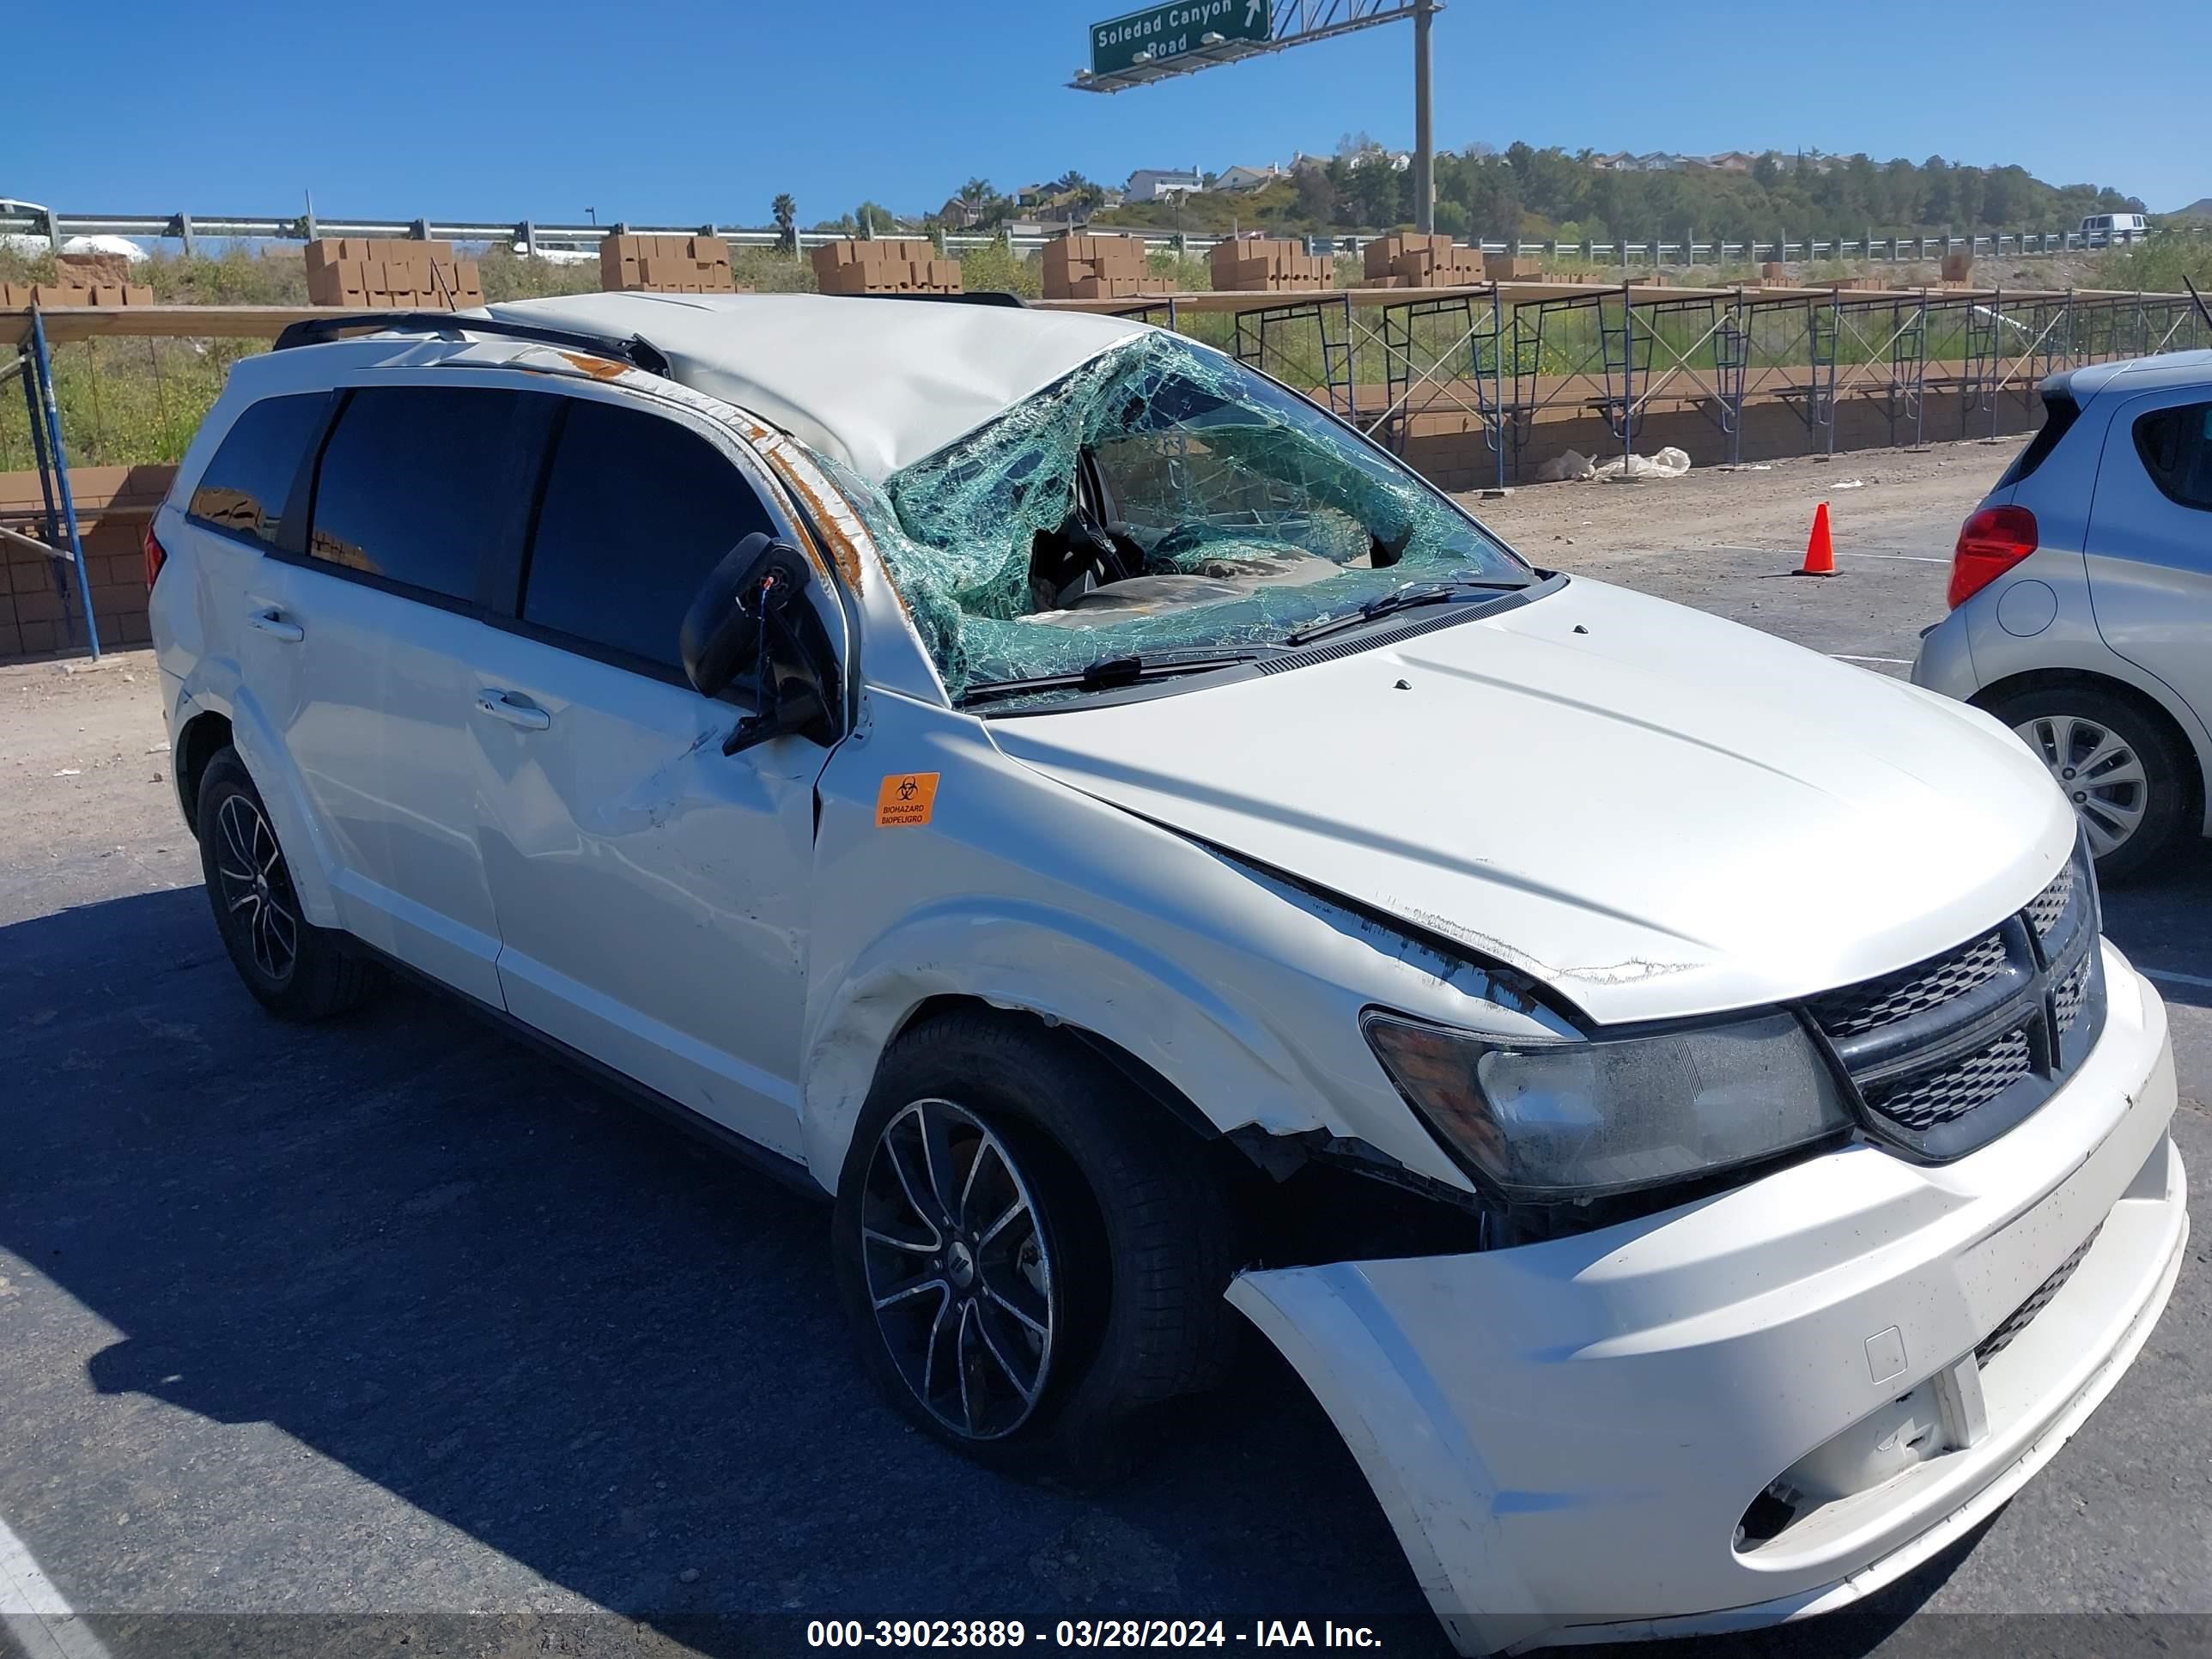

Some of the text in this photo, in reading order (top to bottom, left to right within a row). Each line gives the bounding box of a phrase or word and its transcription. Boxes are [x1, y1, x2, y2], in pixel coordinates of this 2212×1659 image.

[1098, 0, 1231, 47] Soledad Canyon
[1147, 33, 1187, 58] Road
[883, 805, 925, 814] BIOHAZARD
[881, 815, 923, 824] BIOPELIGRO
